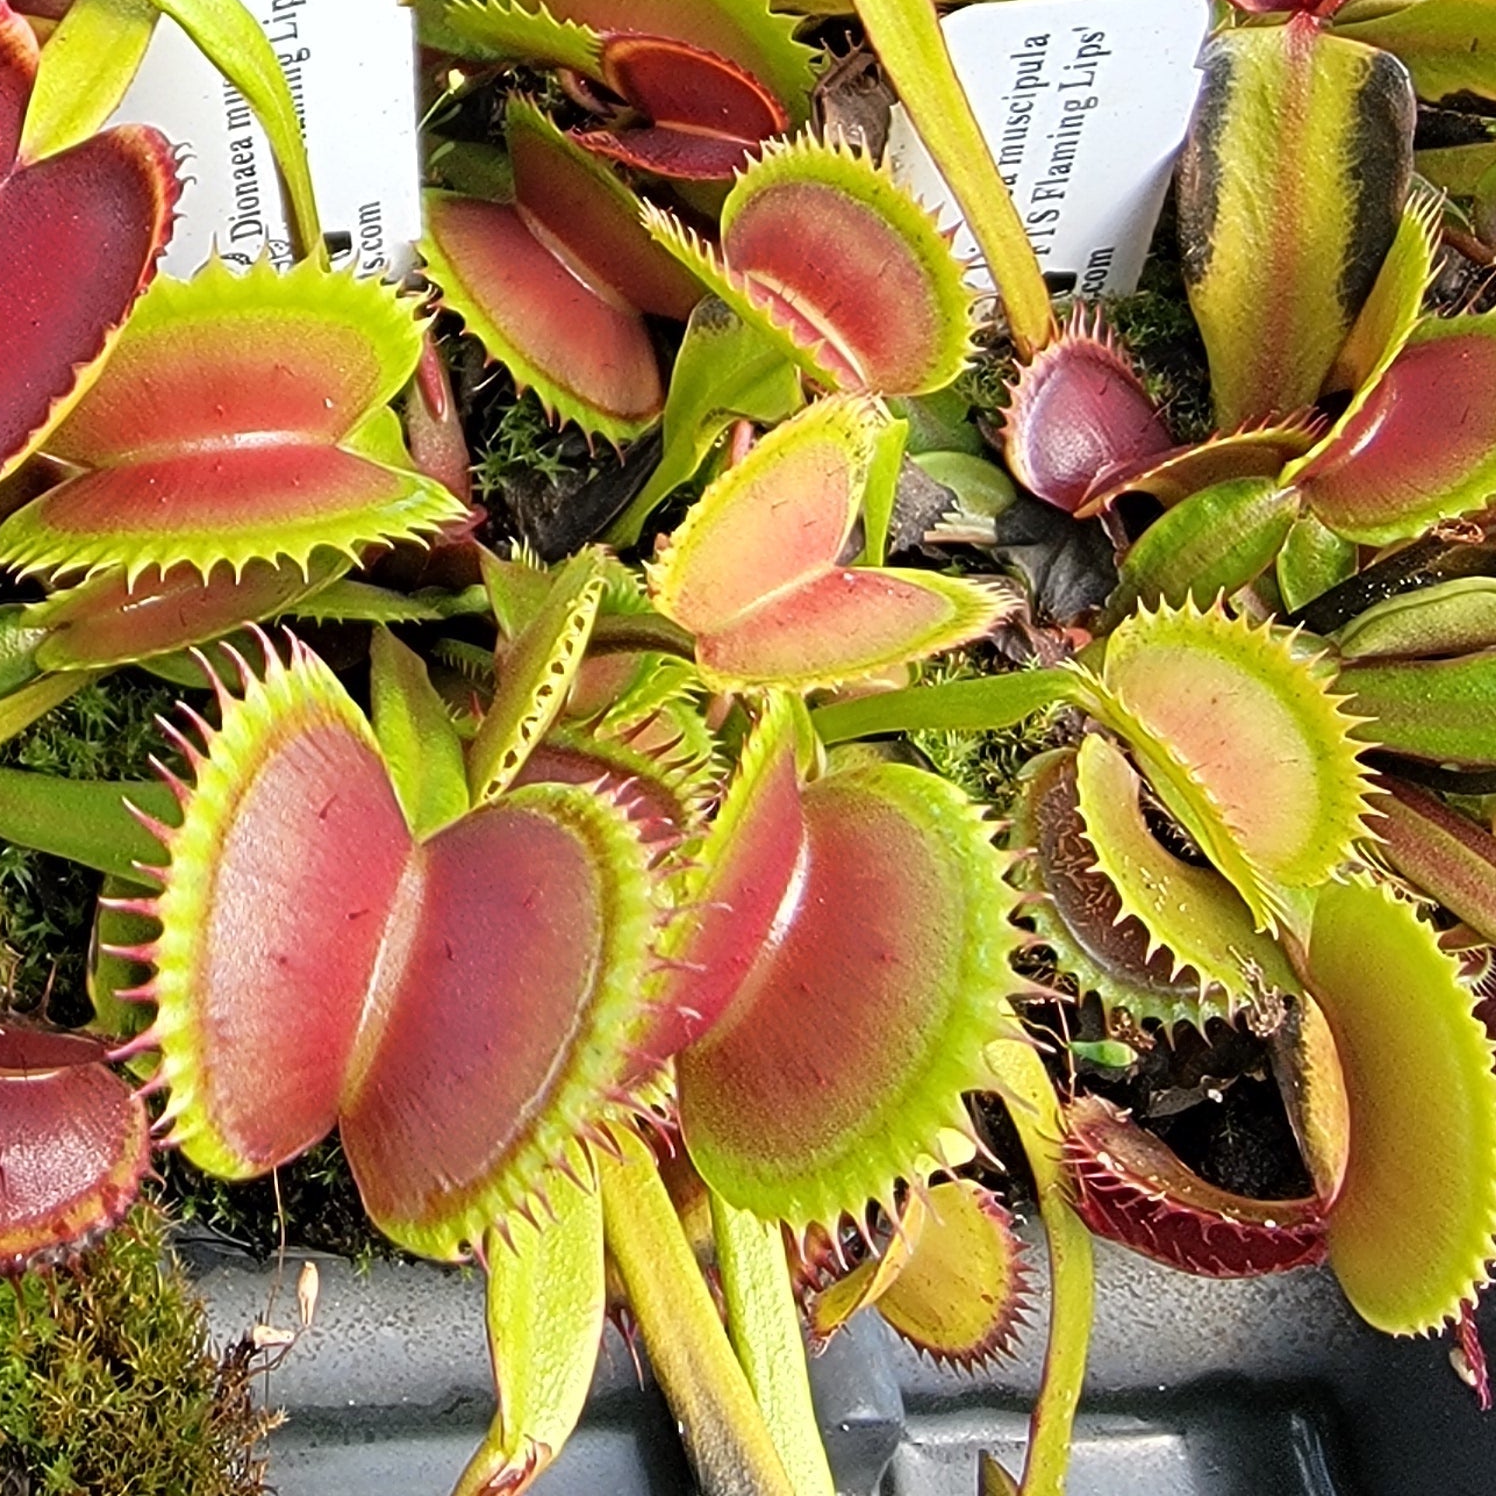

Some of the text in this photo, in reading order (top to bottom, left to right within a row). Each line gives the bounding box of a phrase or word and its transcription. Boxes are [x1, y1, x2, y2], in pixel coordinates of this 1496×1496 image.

[998, 33, 1051, 167] muscipula
[1058, 26, 1113, 93] Lips'
[227, 136, 264, 244] Dionaea
[1031, 95, 1100, 206] Flaming
